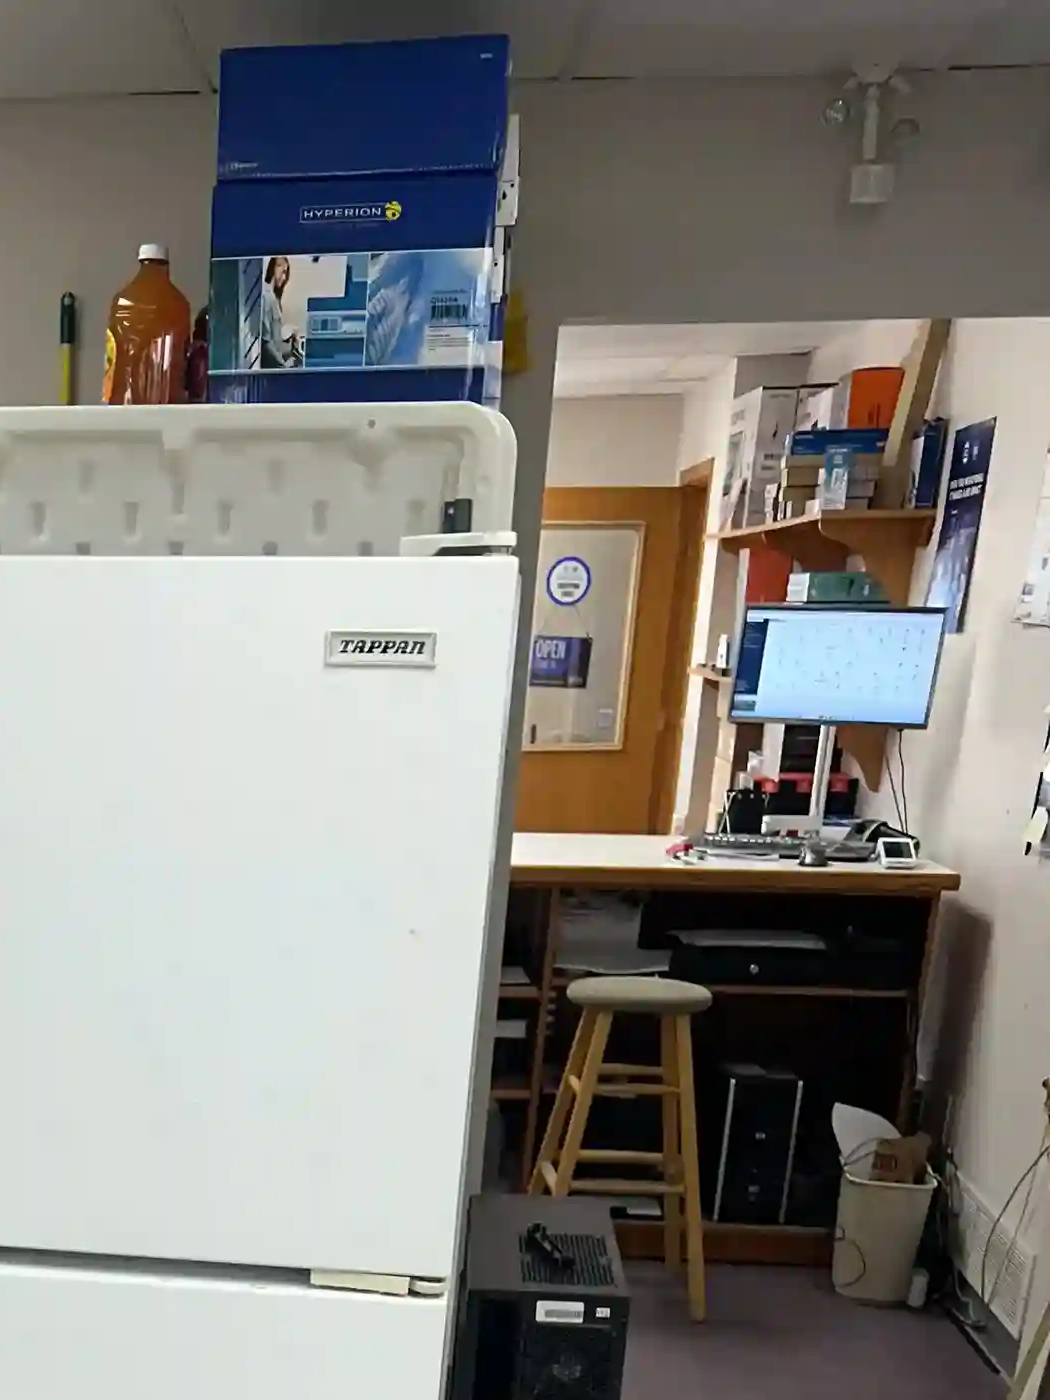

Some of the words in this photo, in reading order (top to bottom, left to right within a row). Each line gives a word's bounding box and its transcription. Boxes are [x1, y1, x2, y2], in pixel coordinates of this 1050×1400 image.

[304, 207, 381, 218] HYPERION
[339, 639, 426, 655] TAPPAN
[535, 640, 567, 660] OPEN
